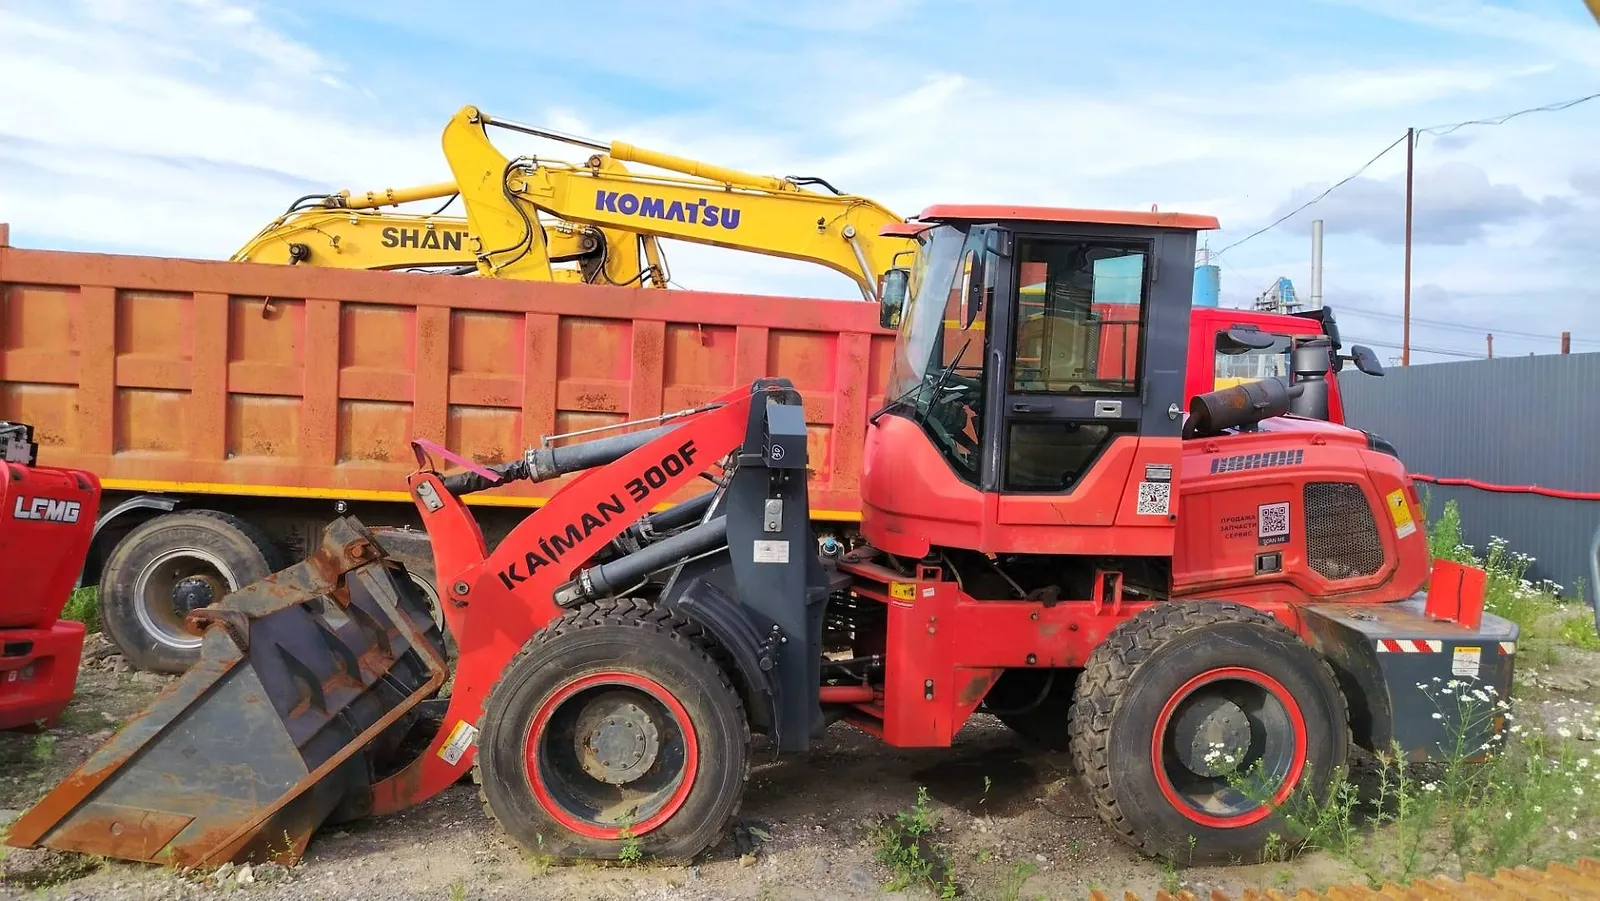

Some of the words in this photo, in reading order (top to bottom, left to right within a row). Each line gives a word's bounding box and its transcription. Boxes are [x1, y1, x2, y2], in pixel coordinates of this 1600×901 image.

[595, 190, 741, 230] KOMATSU
[381, 226, 469, 251] SHAN
[624, 439, 698, 504] 300F
[14, 495, 81, 523] LCMG
[1221, 514, 1256, 523] ПРОДАЖА
[1220, 522, 1257, 532] ЗАПЧАСТИ
[1225, 530, 1253, 540] СЕРВИС
